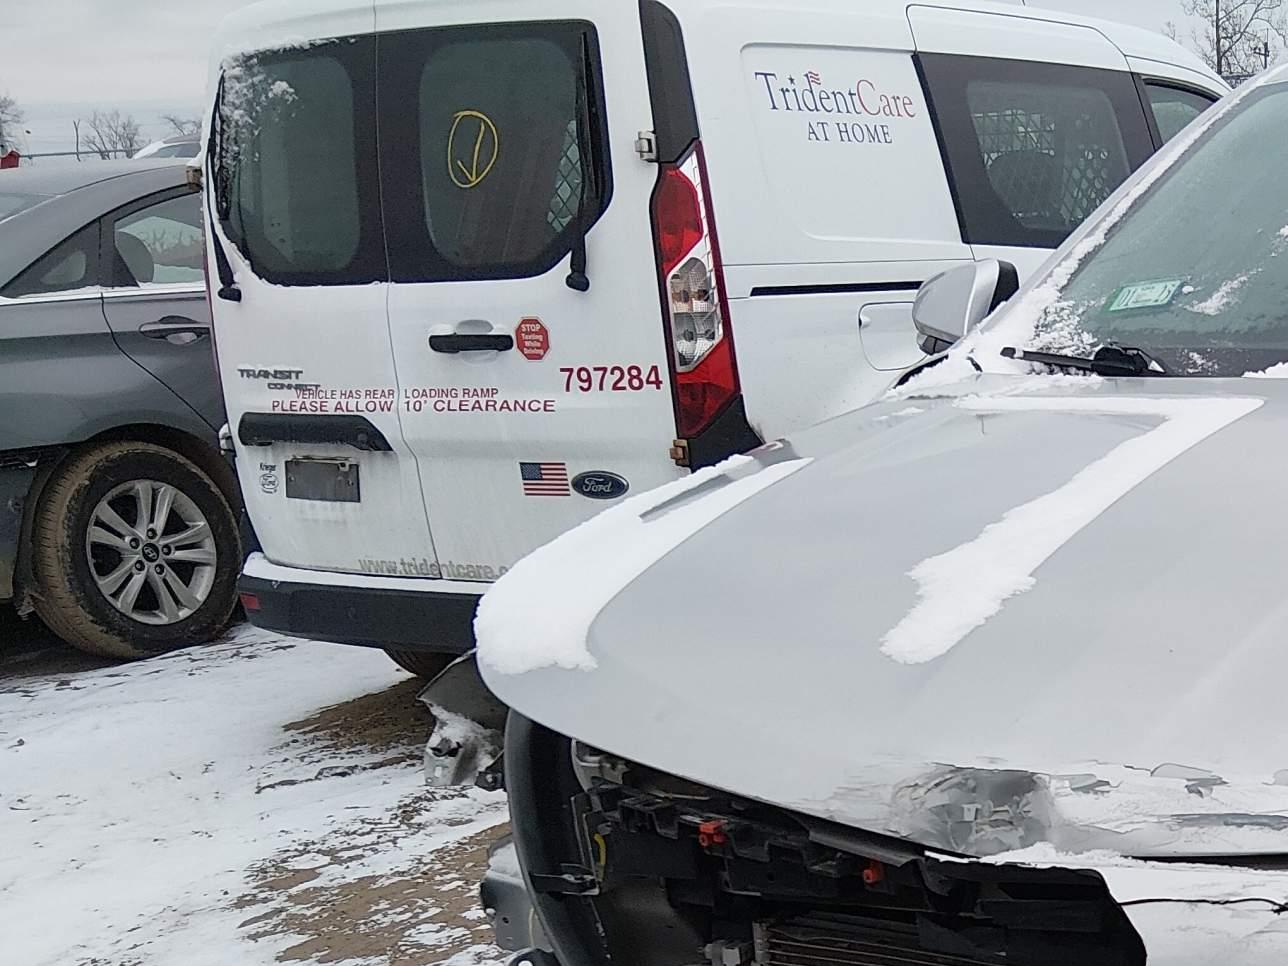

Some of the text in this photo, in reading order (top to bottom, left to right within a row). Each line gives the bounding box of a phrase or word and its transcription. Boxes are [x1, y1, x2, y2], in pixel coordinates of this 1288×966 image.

[755, 71, 916, 118] TridentCare
[808, 121, 892, 144] AT HOME
[521, 323, 540, 332] STOP
[237, 368, 303, 380] TRANSIT
[560, 365, 663, 392] 797284
[295, 388, 499, 400] VEHICLE HAS REAR LOADING RAMP
[271, 400, 328, 412] PLEASE
[334, 400, 393, 412] ALLOW
[433, 400, 556, 412] CLEARANCE
[582, 477, 612, 492] Ford
